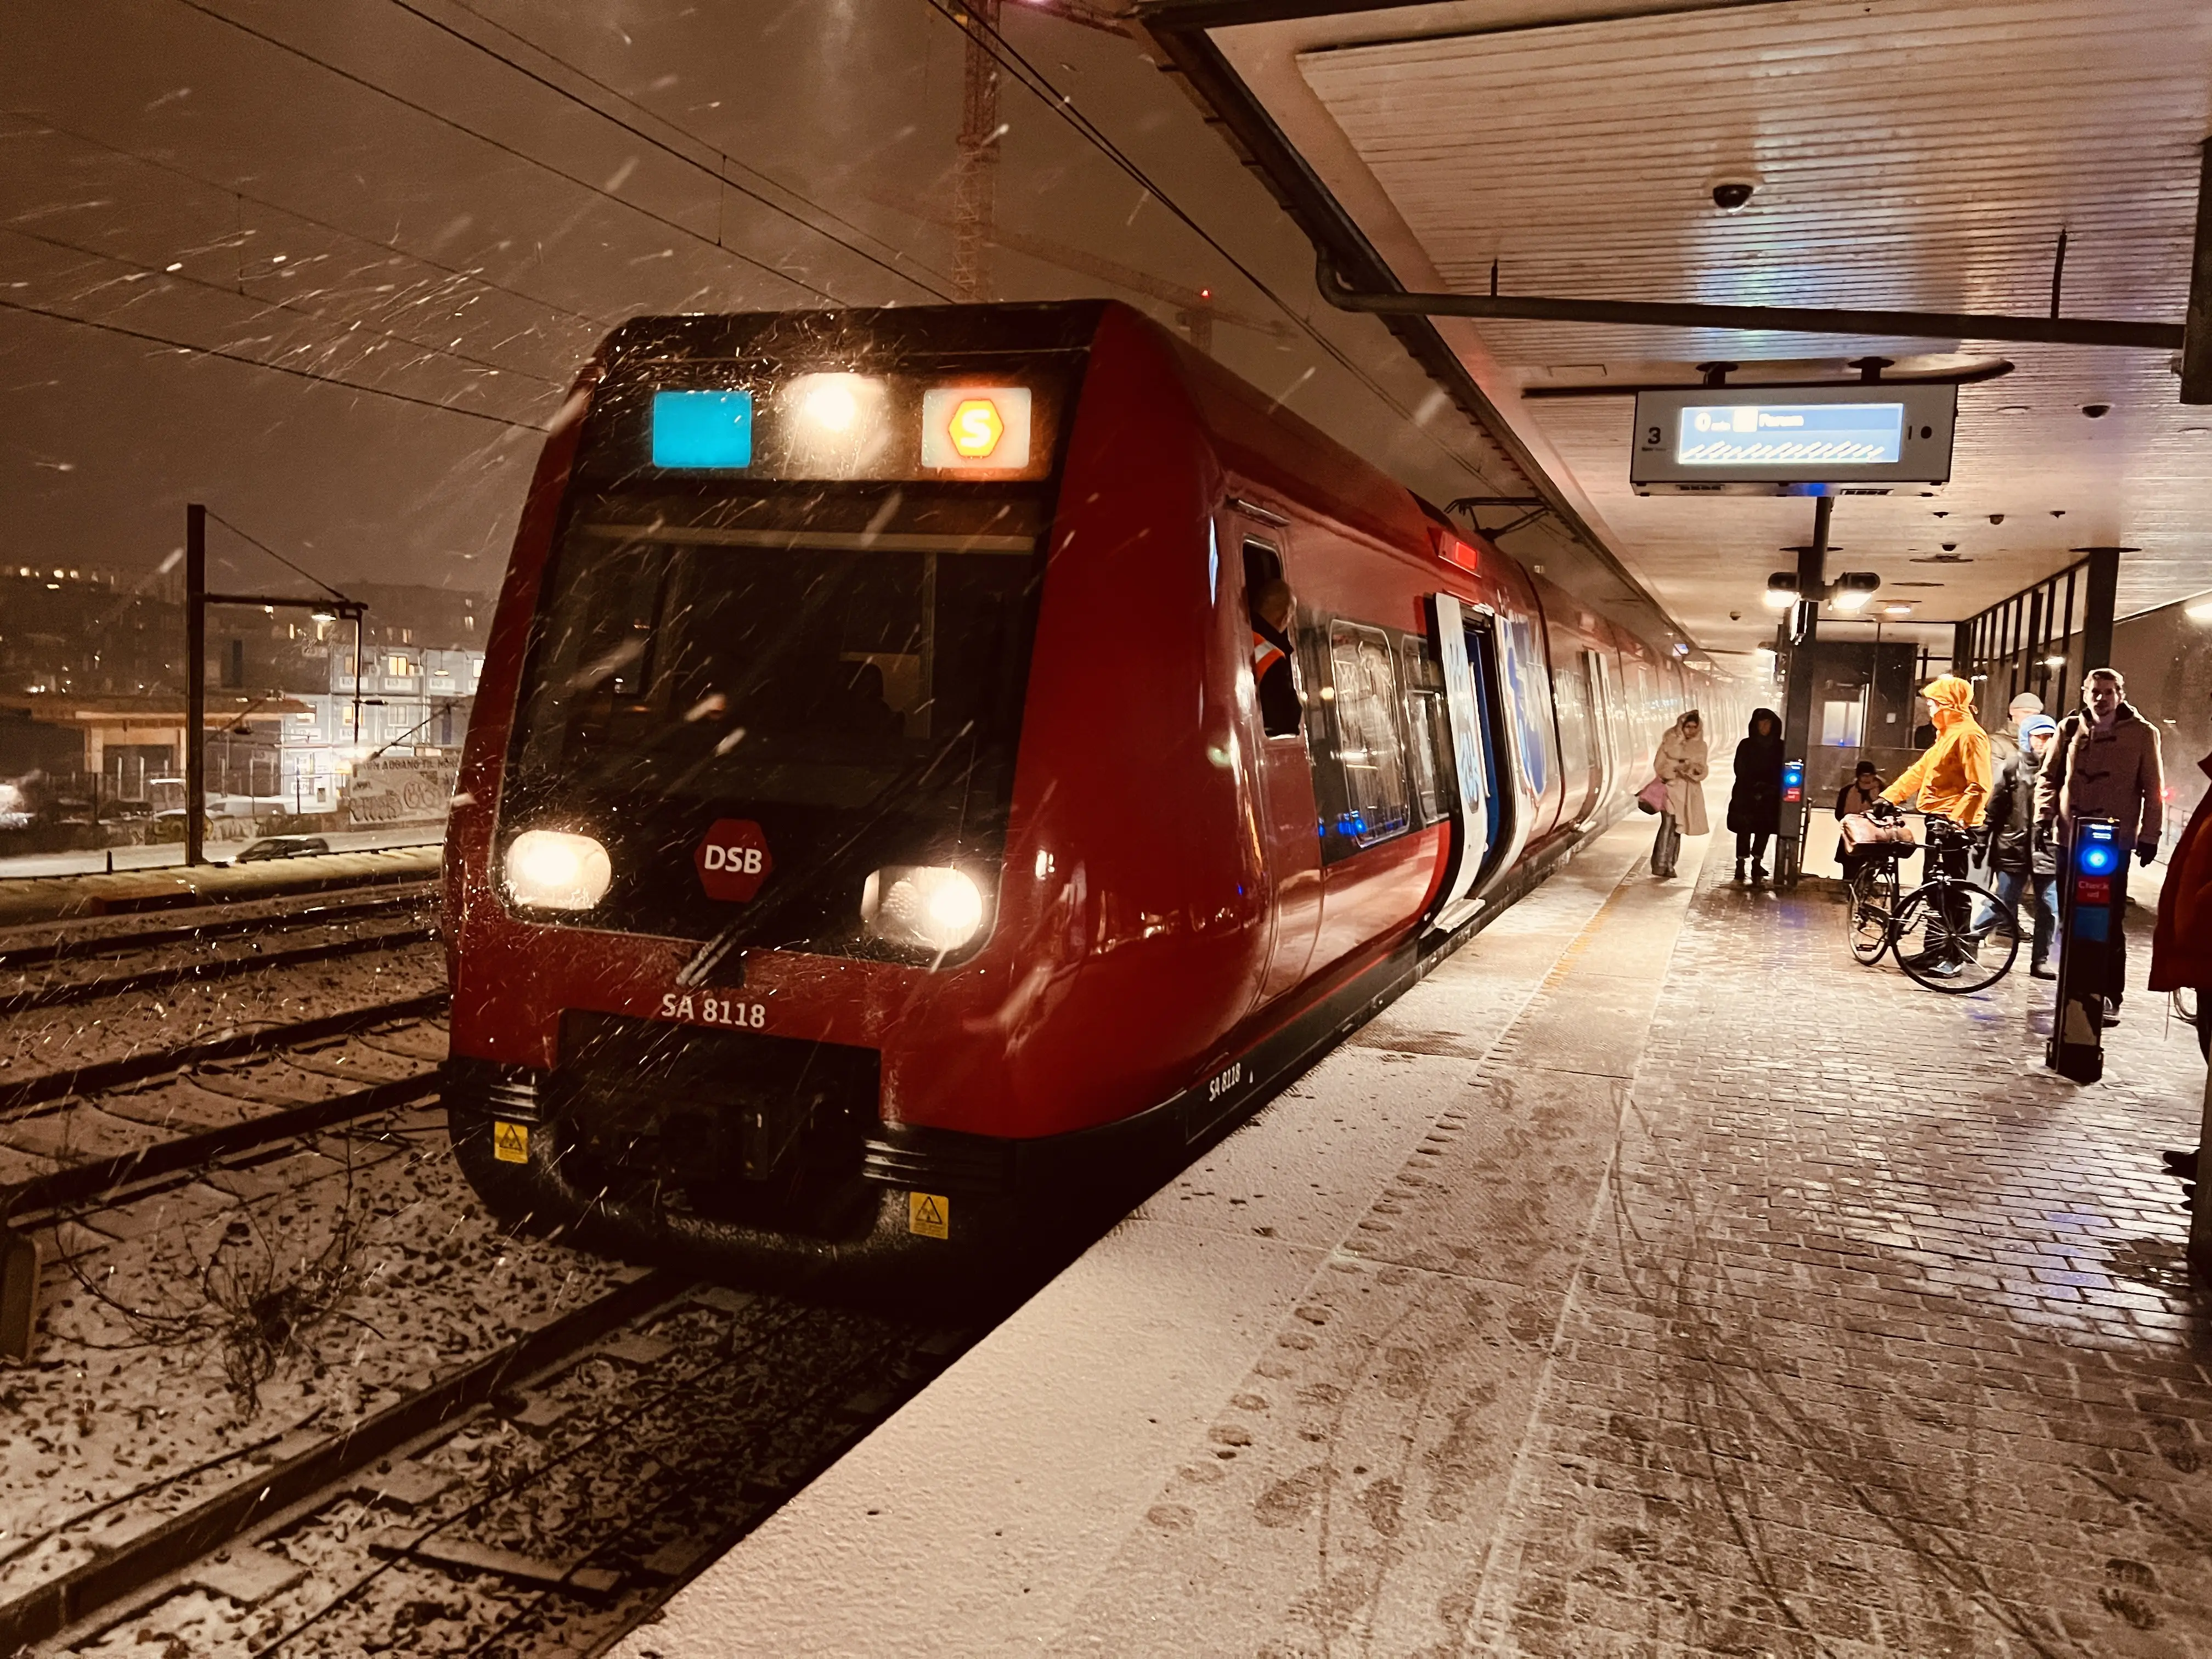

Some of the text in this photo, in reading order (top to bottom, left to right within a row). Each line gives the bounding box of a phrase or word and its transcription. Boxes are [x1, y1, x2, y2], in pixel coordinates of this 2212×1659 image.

[960, 409, 991, 448] S
[1647, 427, 1661, 444] 3
[704, 844, 762, 874] DSB
[661, 993, 765, 1028] SA 8118
